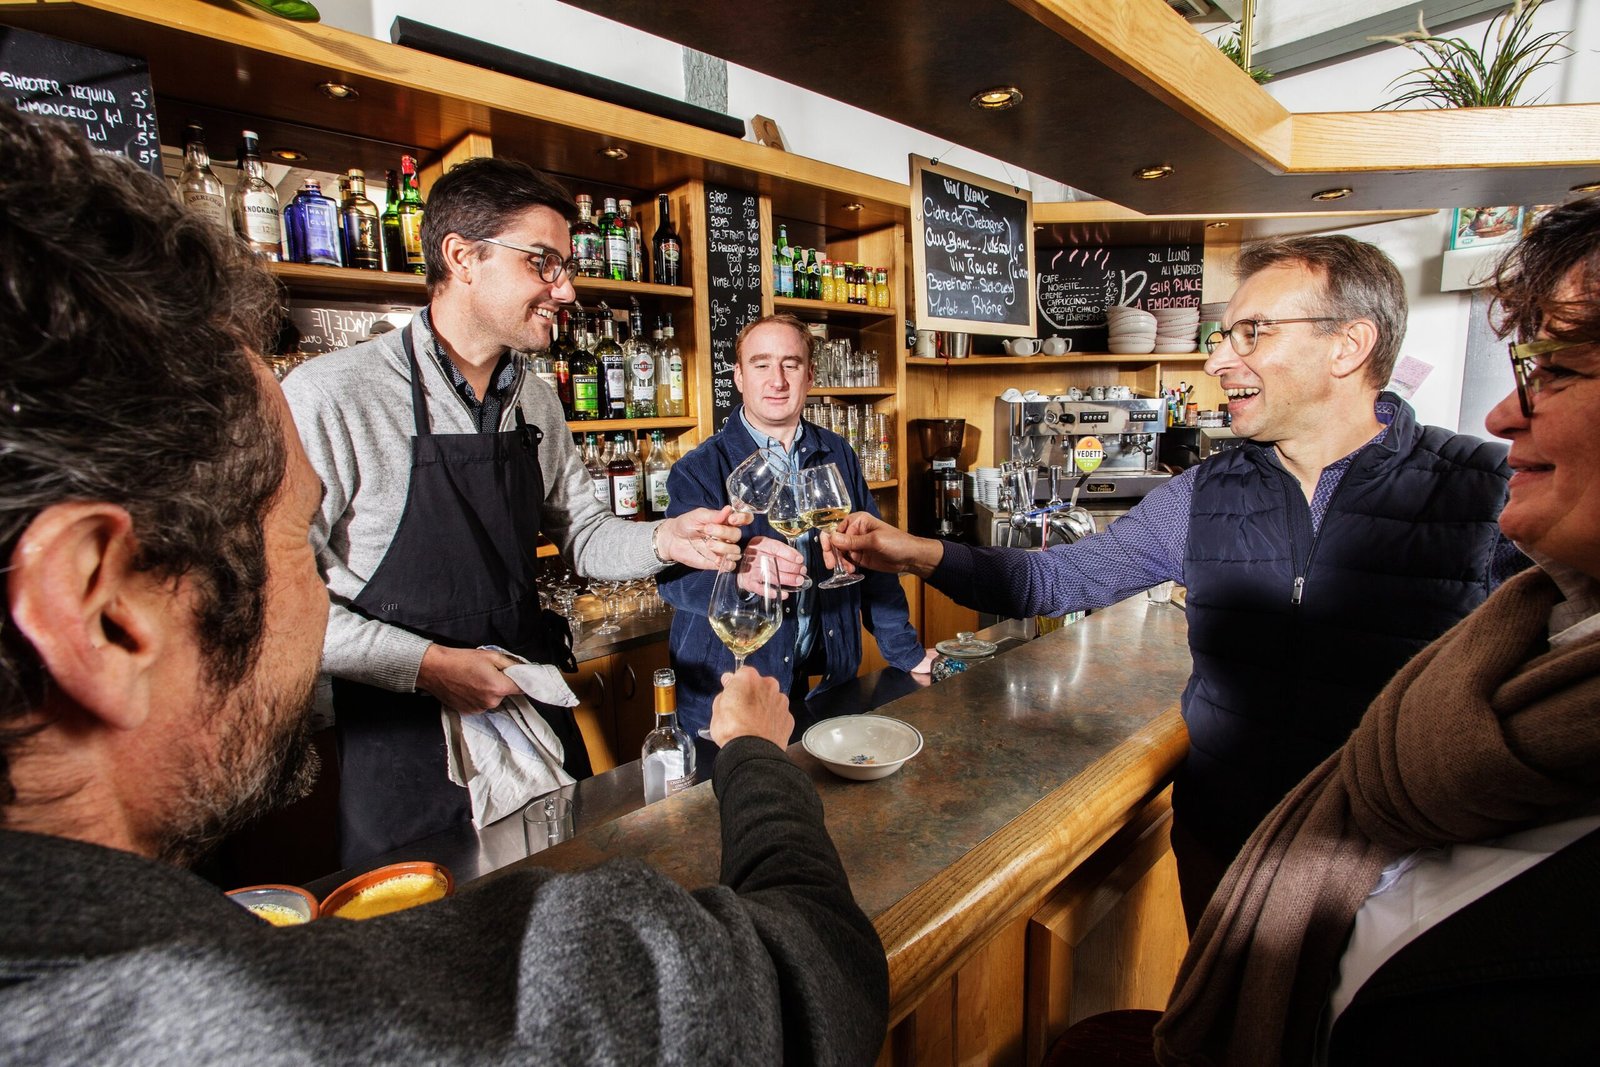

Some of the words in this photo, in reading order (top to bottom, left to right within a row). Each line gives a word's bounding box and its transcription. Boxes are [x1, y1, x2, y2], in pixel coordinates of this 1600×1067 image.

[0, 71, 63, 97] SHOOTER
[68, 84, 116, 107] TEQUILA
[923, 197, 950, 222] Cidre
[950, 209, 963, 227] de
[962, 209, 1006, 232] Bretagne
[1150, 283, 1171, 296] SUR
[1173, 278, 1203, 293] PLACE
[928, 294, 958, 317] Merlot
[972, 295, 1003, 316] Rhône
[1047, 297, 1087, 307] CAPPUCCINO
